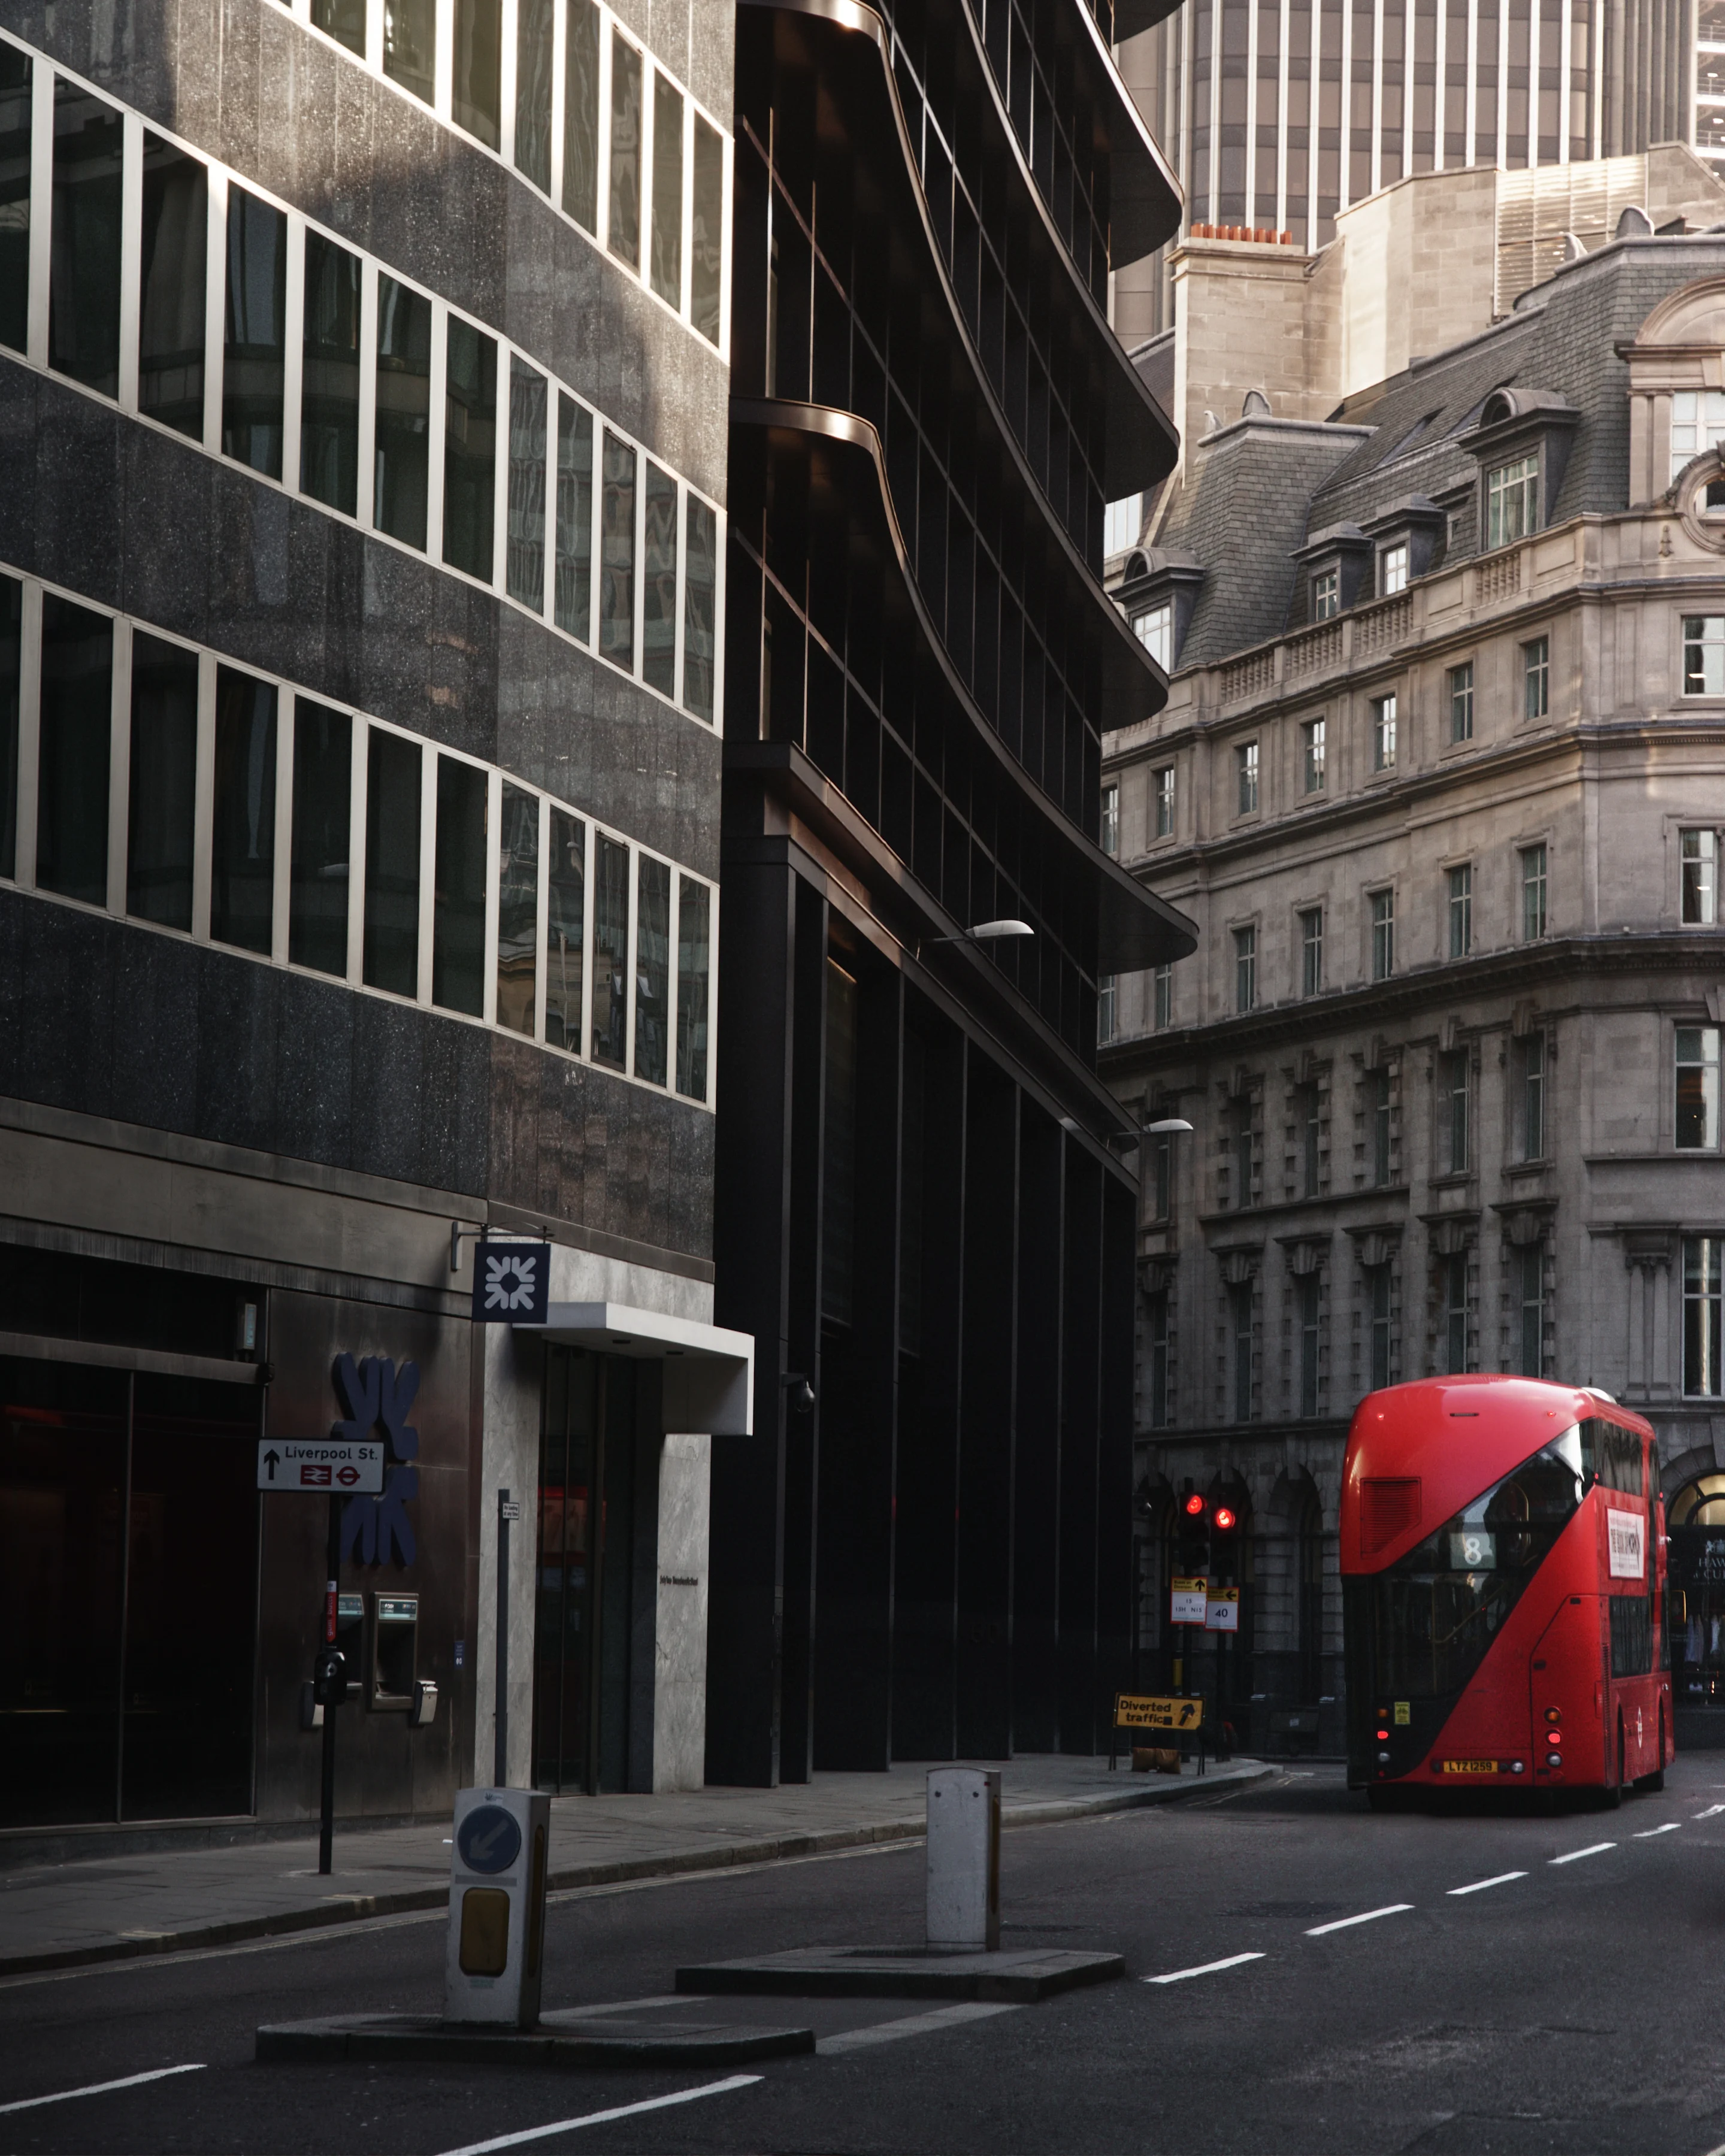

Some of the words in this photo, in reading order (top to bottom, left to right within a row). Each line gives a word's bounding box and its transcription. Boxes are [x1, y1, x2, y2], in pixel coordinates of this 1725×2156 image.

[285, 1446, 352, 1461] Liverpool
[358, 1448, 378, 1459] St.
[1464, 1537, 1482, 1565] 8
[1215, 1608, 1228, 1618] 40
[1120, 1700, 1172, 1712] Diverted
[1126, 1712, 1163, 1724] traffic
